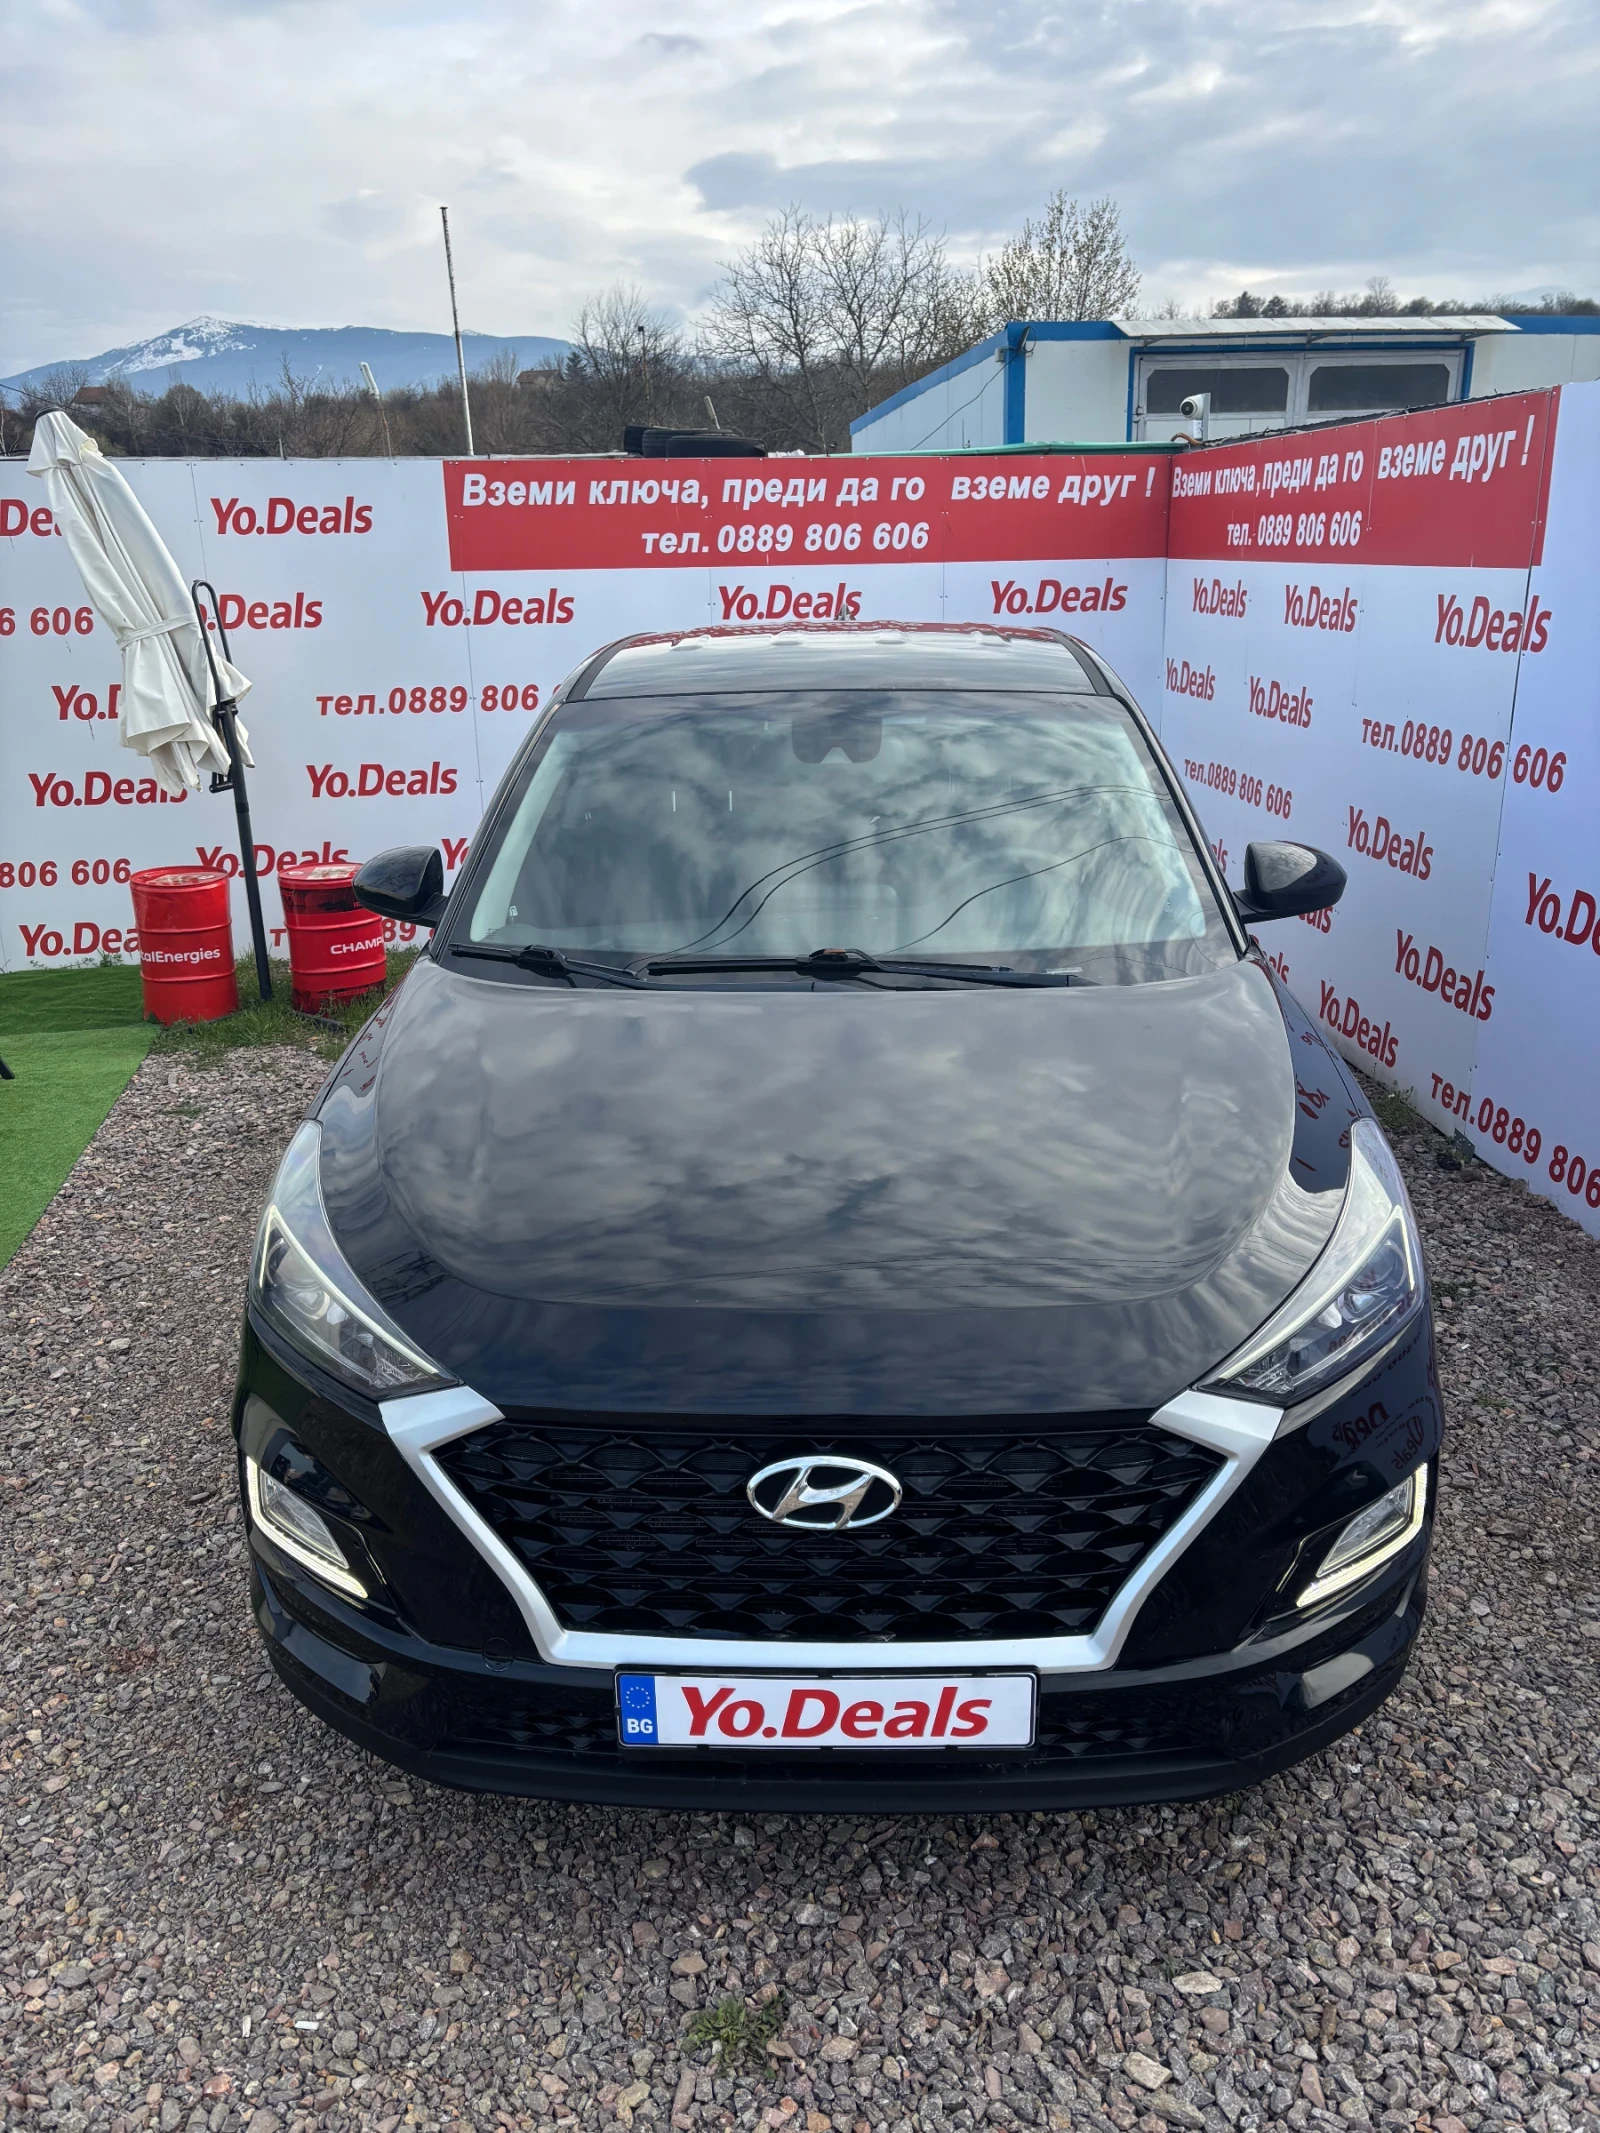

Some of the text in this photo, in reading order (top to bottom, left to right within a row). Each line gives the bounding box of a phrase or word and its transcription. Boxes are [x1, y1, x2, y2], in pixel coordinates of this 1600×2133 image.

[1172, 466, 1212, 498] Вземи
[1262, 457, 1313, 499] преди
[1314, 458, 1337, 491] да
[1343, 451, 1363, 482] го
[1377, 439, 1445, 480] вземе
[1448, 429, 1517, 483] друг
[463, 474, 575, 506] Вземи
[589, 480, 708, 509] ключа,
[723, 479, 827, 510] преди
[836, 478, 878, 506] да
[891, 477, 925, 500] го
[951, 476, 1050, 500] вземе
[1058, 475, 1136, 506] друг
[211, 496, 372, 535] Yo.Deals
[1227, 511, 1362, 547] тел. 0889 806 606
[642, 522, 929, 553] тел. 0889 806 606
[421, 588, 574, 626] Yo.Deals
[719, 583, 861, 622] Yo.Deals
[992, 578, 1127, 614] Yo.Deals
[1193, 578, 1247, 617] Yo.Deals
[1284, 585, 1357, 632] Yo.Deals
[30, 607, 93, 635] 606
[1434, 593, 1552, 653] Yo.Deals
[1165, 657, 1216, 701] Yo.Deals
[316, 686, 467, 716] тел.0889
[480, 684, 538, 712] 806
[1249, 675, 1313, 729] Yo.Deals
[1362, 718, 1567, 792] тел.0889 806 606
[306, 761, 457, 798] Yo.Deals
[1184, 757, 1293, 820] тел.0889 806 606
[1347, 806, 1433, 879] Yo.Deals
[0, 861, 57, 888] 806
[72, 858, 128, 885] 606
[1394, 930, 1495, 1021] Yo.Deals
[1318, 980, 1399, 1068] Yo.Deals
[1431, 1073, 1600, 1208] тел.0889 806
[627, 1719, 653, 1733] BG
[682, 1686, 991, 1739] Yo.Deals
